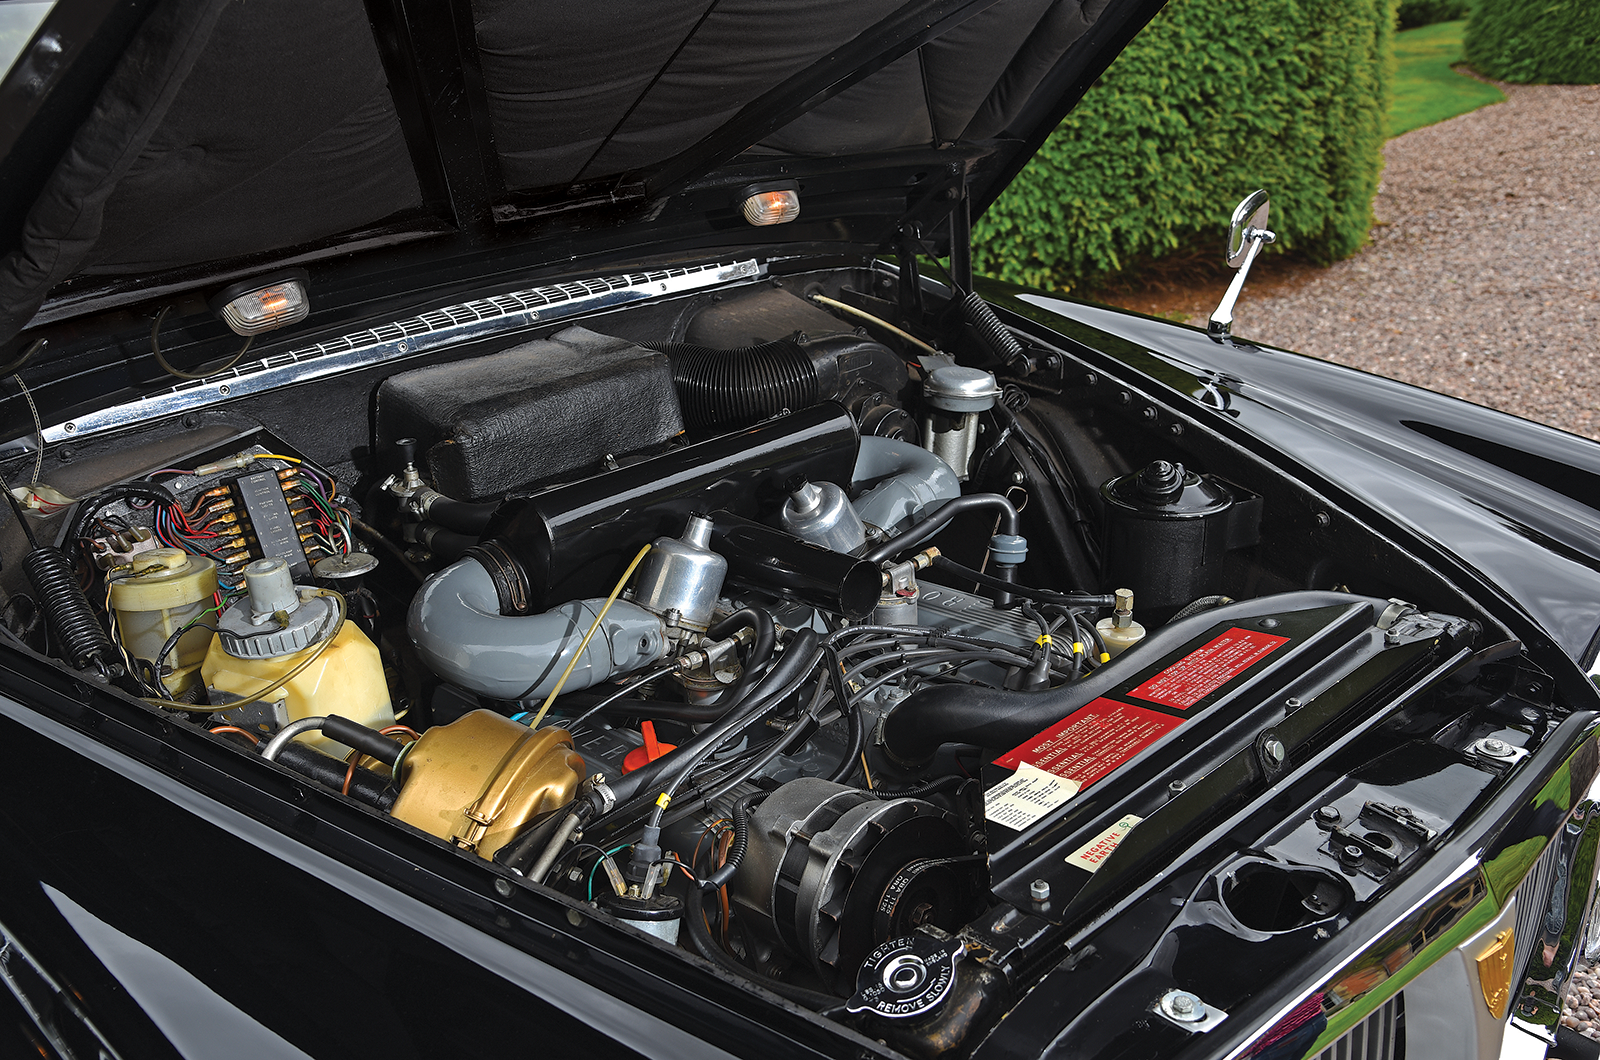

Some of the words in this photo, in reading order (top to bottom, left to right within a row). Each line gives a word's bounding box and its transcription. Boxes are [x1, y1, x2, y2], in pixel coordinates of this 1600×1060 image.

[1032, 739, 1054, 753] MOST
[1056, 713, 1099, 738] IMPORTANT.
[1032, 745, 1067, 768] SSENTIAL
[1046, 750, 1084, 774] SSENTIAL
[1058, 753, 1096, 778] SSENTIAL
[1080, 832, 1120, 860] NEGATIVE
[1089, 842, 1119, 864] EARTH
[864, 937, 915, 968] TIGHTEN
[876, 999, 925, 1013] REMOVE
[926, 965, 950, 1002] SLOWLY
